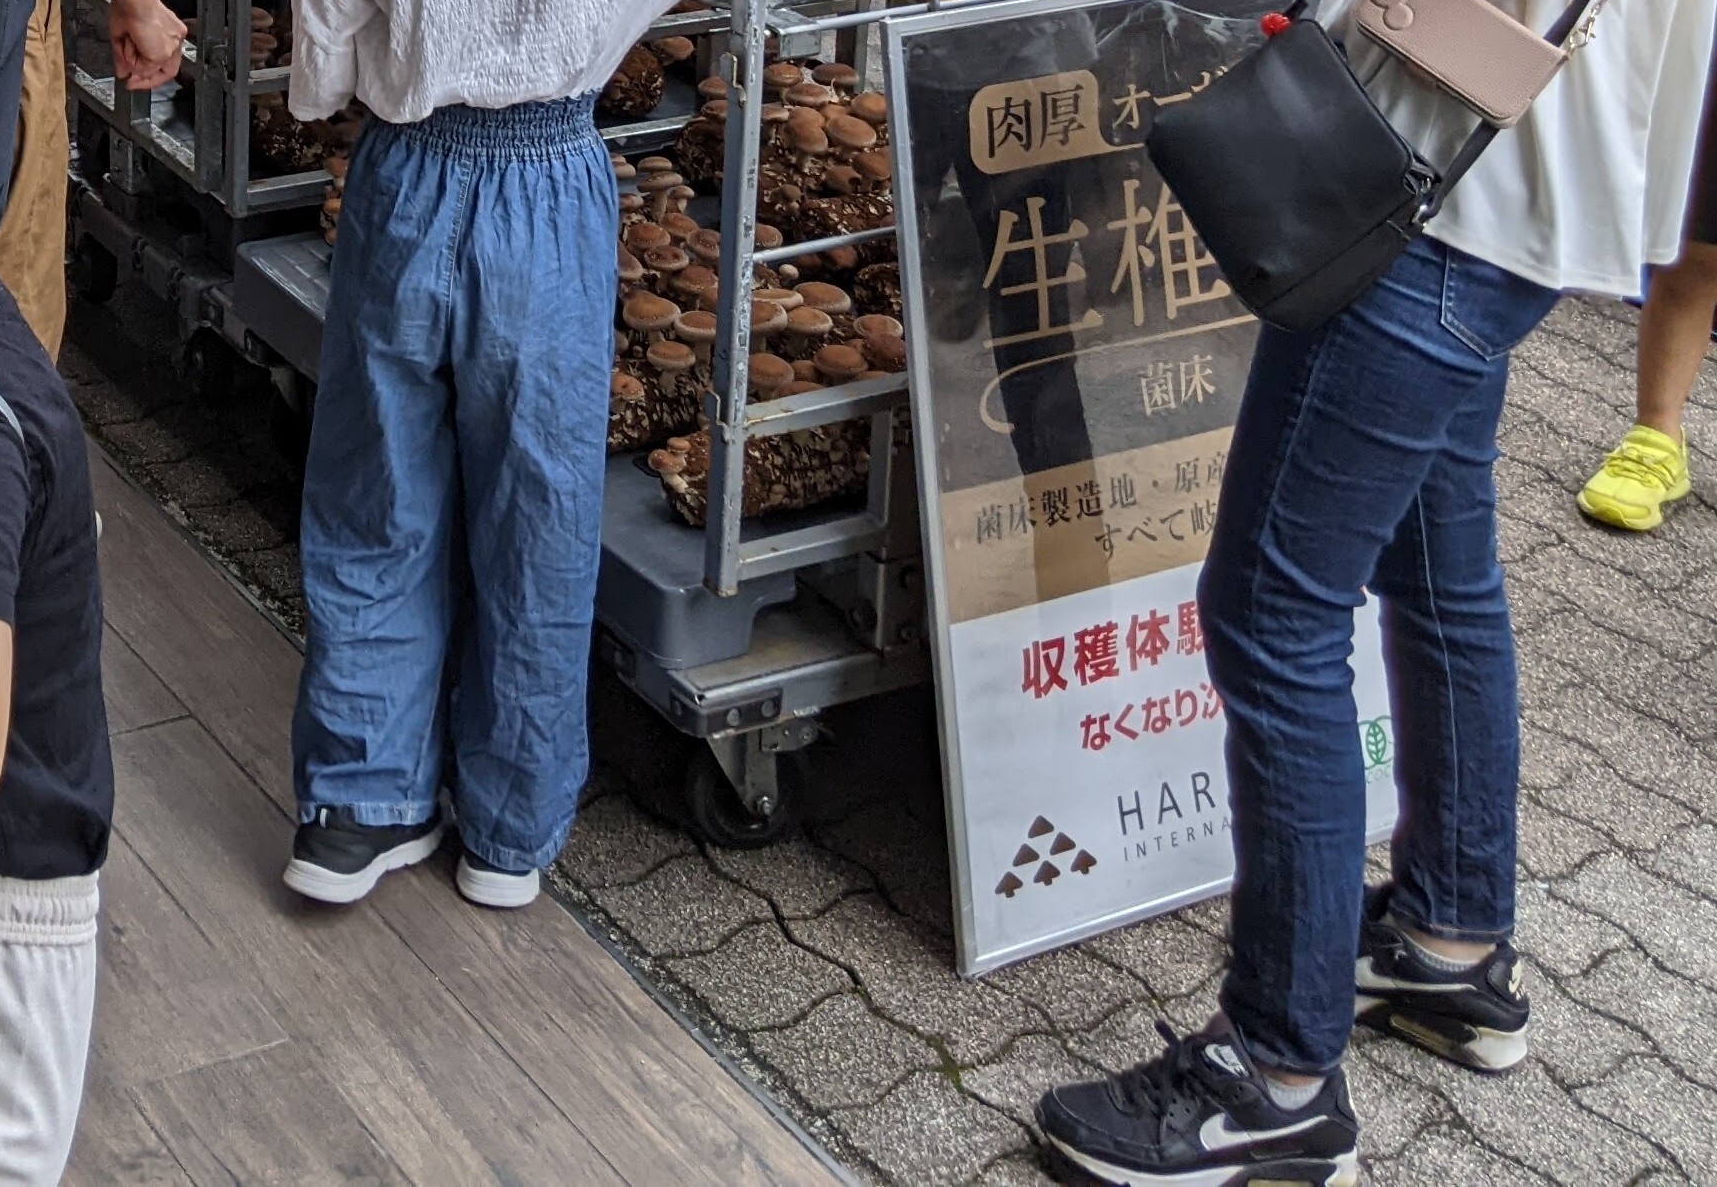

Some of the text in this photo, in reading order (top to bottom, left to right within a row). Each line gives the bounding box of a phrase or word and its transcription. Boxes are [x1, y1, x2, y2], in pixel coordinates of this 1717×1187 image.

[986, 83, 1085, 158] 肉厚
[982, 178, 1231, 349] 生椎
[1138, 354, 1216, 416] 菌床
[1117, 771, 1216, 836] HAR
[1123, 816, 1232, 862] INTERNA
